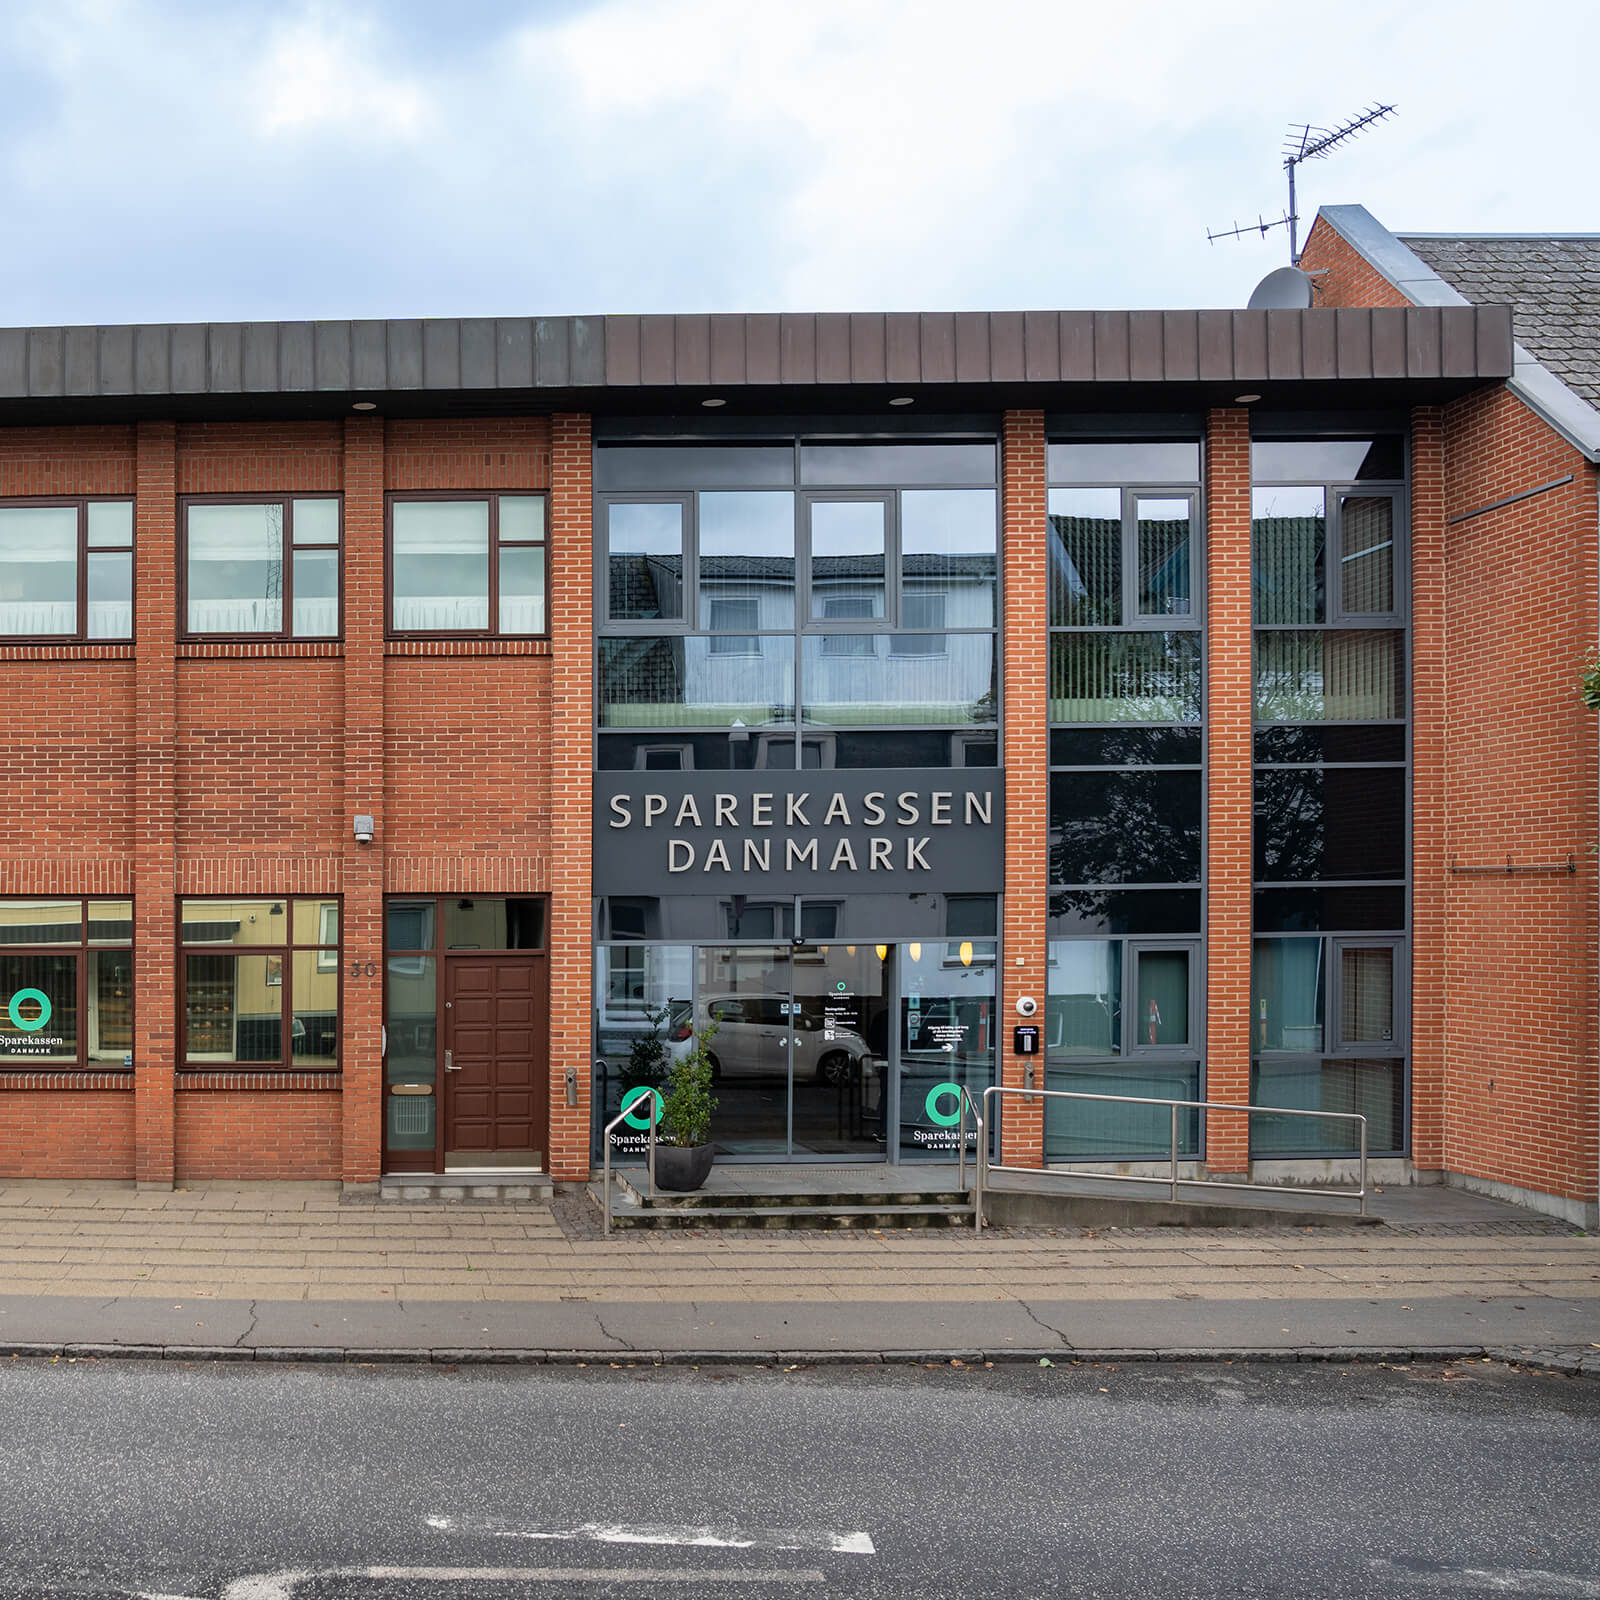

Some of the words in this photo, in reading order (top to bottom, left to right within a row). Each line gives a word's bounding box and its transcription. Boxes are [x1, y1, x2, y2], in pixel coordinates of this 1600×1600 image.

[609, 791, 993, 828] SPAREKASSEN
[667, 837, 932, 873] DANMARK
[351, 962, 377, 978] 30
[0, 1035, 63, 1047] Sparekassen
